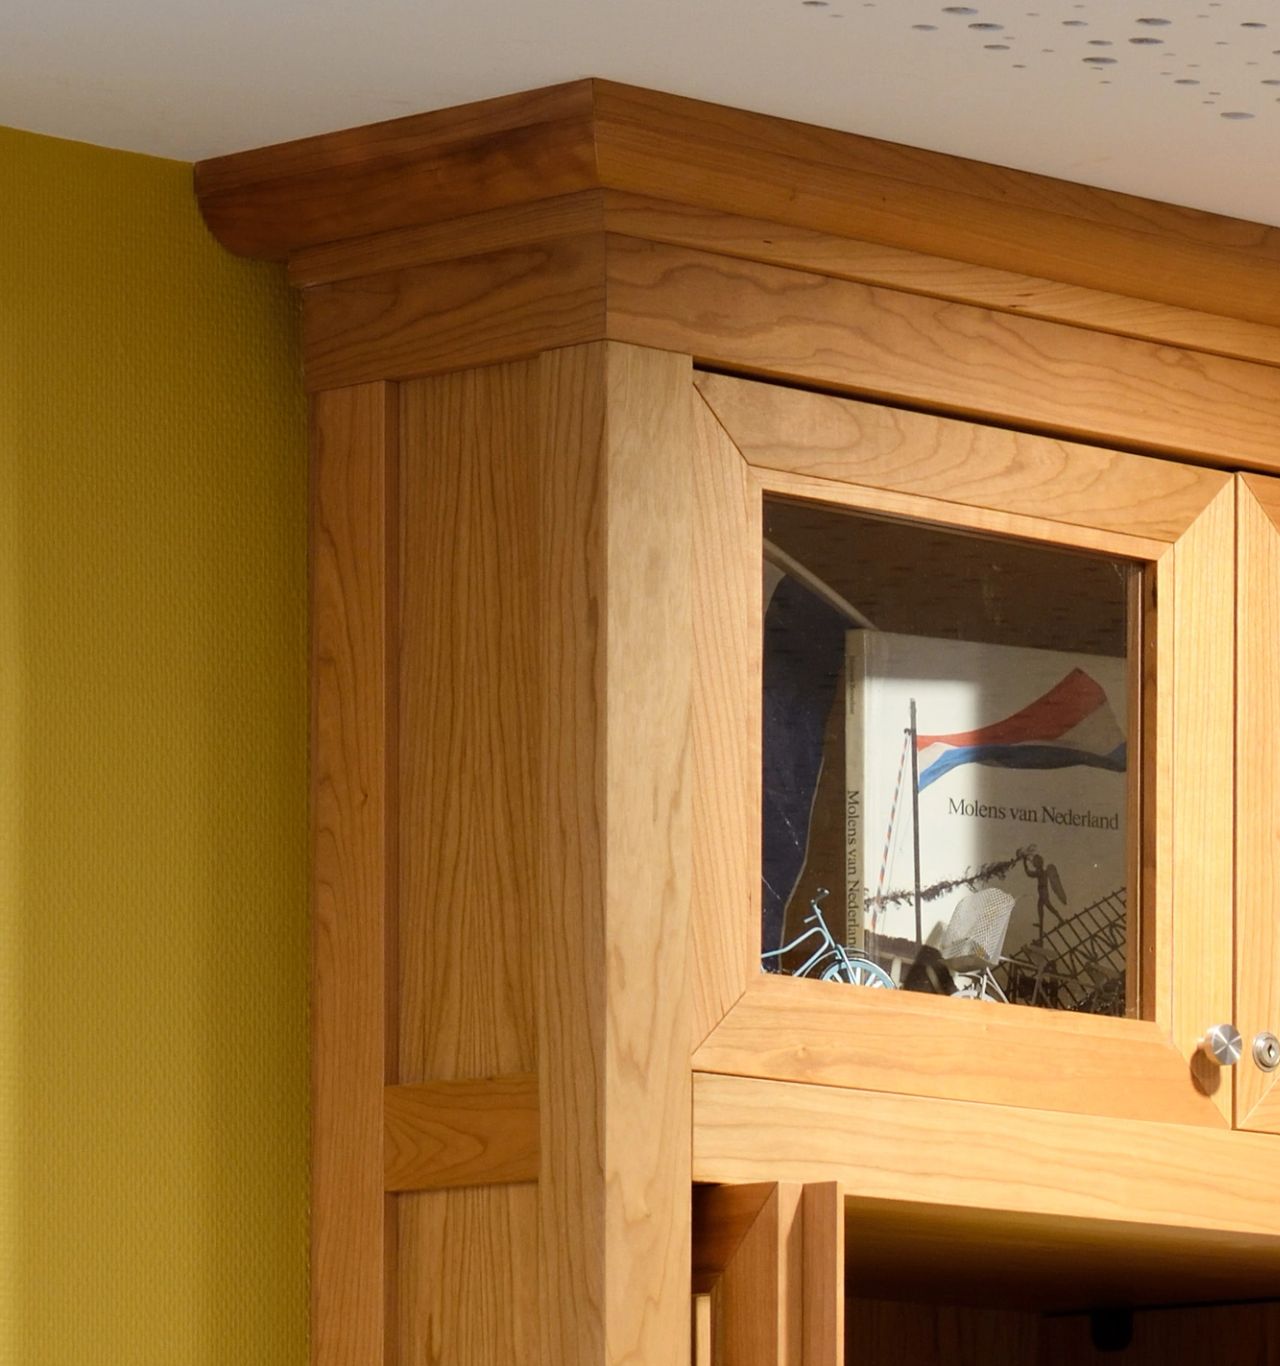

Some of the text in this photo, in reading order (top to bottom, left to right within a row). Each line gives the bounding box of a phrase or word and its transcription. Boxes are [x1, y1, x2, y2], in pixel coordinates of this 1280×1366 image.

[947, 797, 1119, 831] Molens van Nederland
[846, 789, 860, 948] Molens van Nederlan
